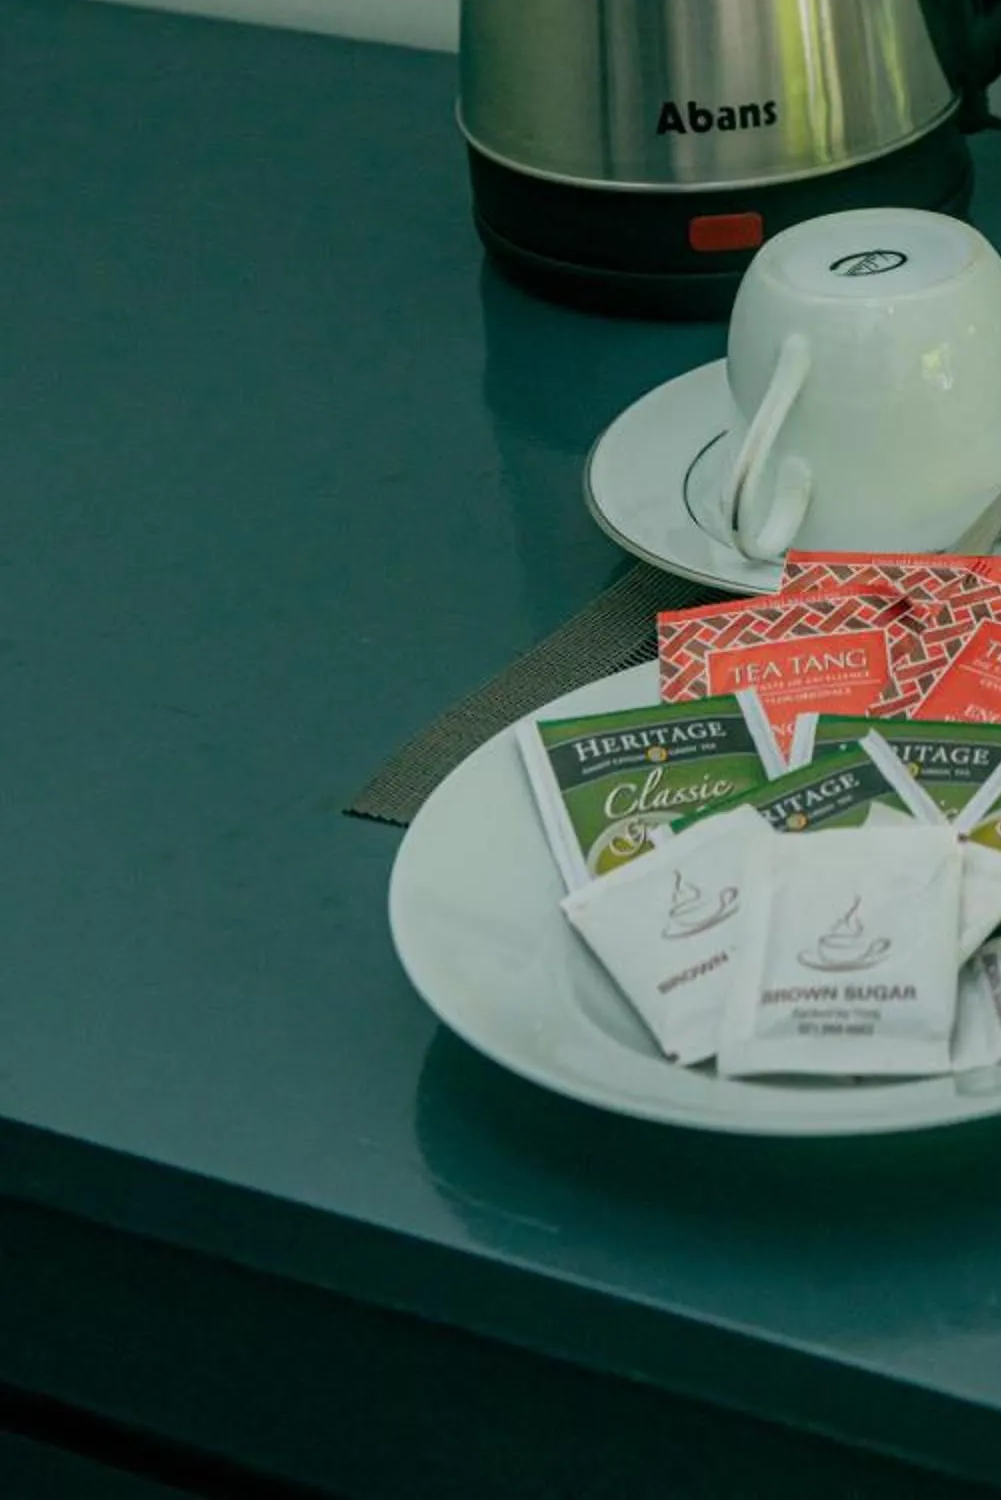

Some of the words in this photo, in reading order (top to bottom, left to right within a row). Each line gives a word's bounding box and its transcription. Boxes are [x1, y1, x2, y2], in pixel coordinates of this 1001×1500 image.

[656, 100, 778, 135] Abans
[728, 658, 783, 685] TEA
[787, 649, 868, 674] TANG
[573, 720, 728, 763] HERITAGE
[896, 745, 991, 766] ITAGE
[604, 766, 734, 819] Classic
[762, 772, 861, 823] RITAGE
[760, 985, 838, 1005] BROWN
[844, 984, 918, 1002] SUGAR
